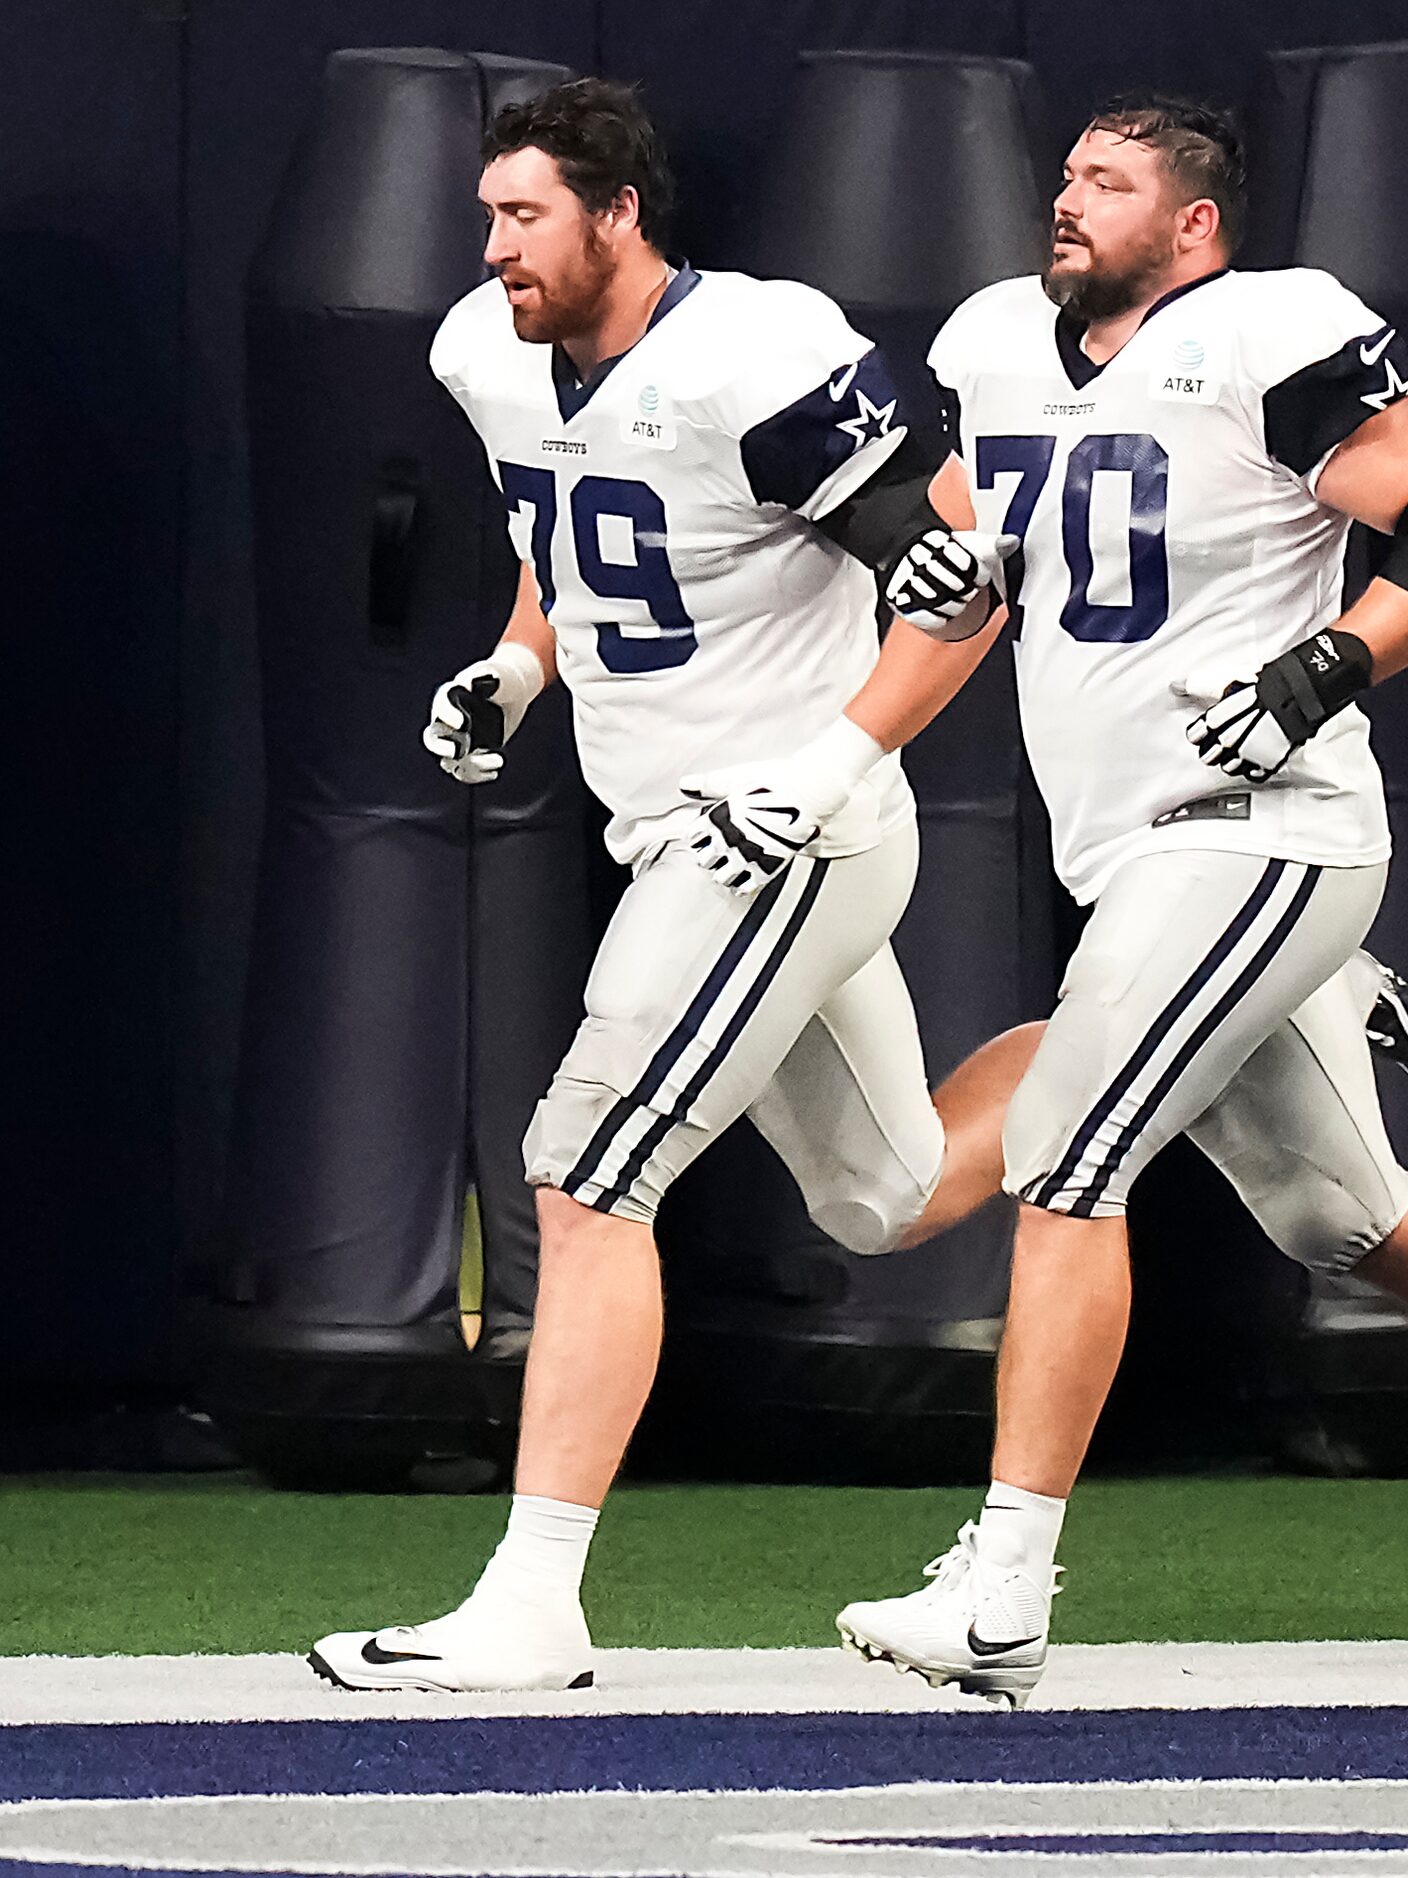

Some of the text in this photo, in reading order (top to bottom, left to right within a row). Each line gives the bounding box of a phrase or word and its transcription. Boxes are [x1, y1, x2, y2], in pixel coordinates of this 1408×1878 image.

[1163, 377, 1206, 395] AT&T
[1042, 402, 1097, 416] COWBOYS
[631, 420, 662, 439] AT&T
[541, 440, 588, 455] COWBOYS
[975, 433, 1170, 643] 70
[495, 459, 700, 674] 79
